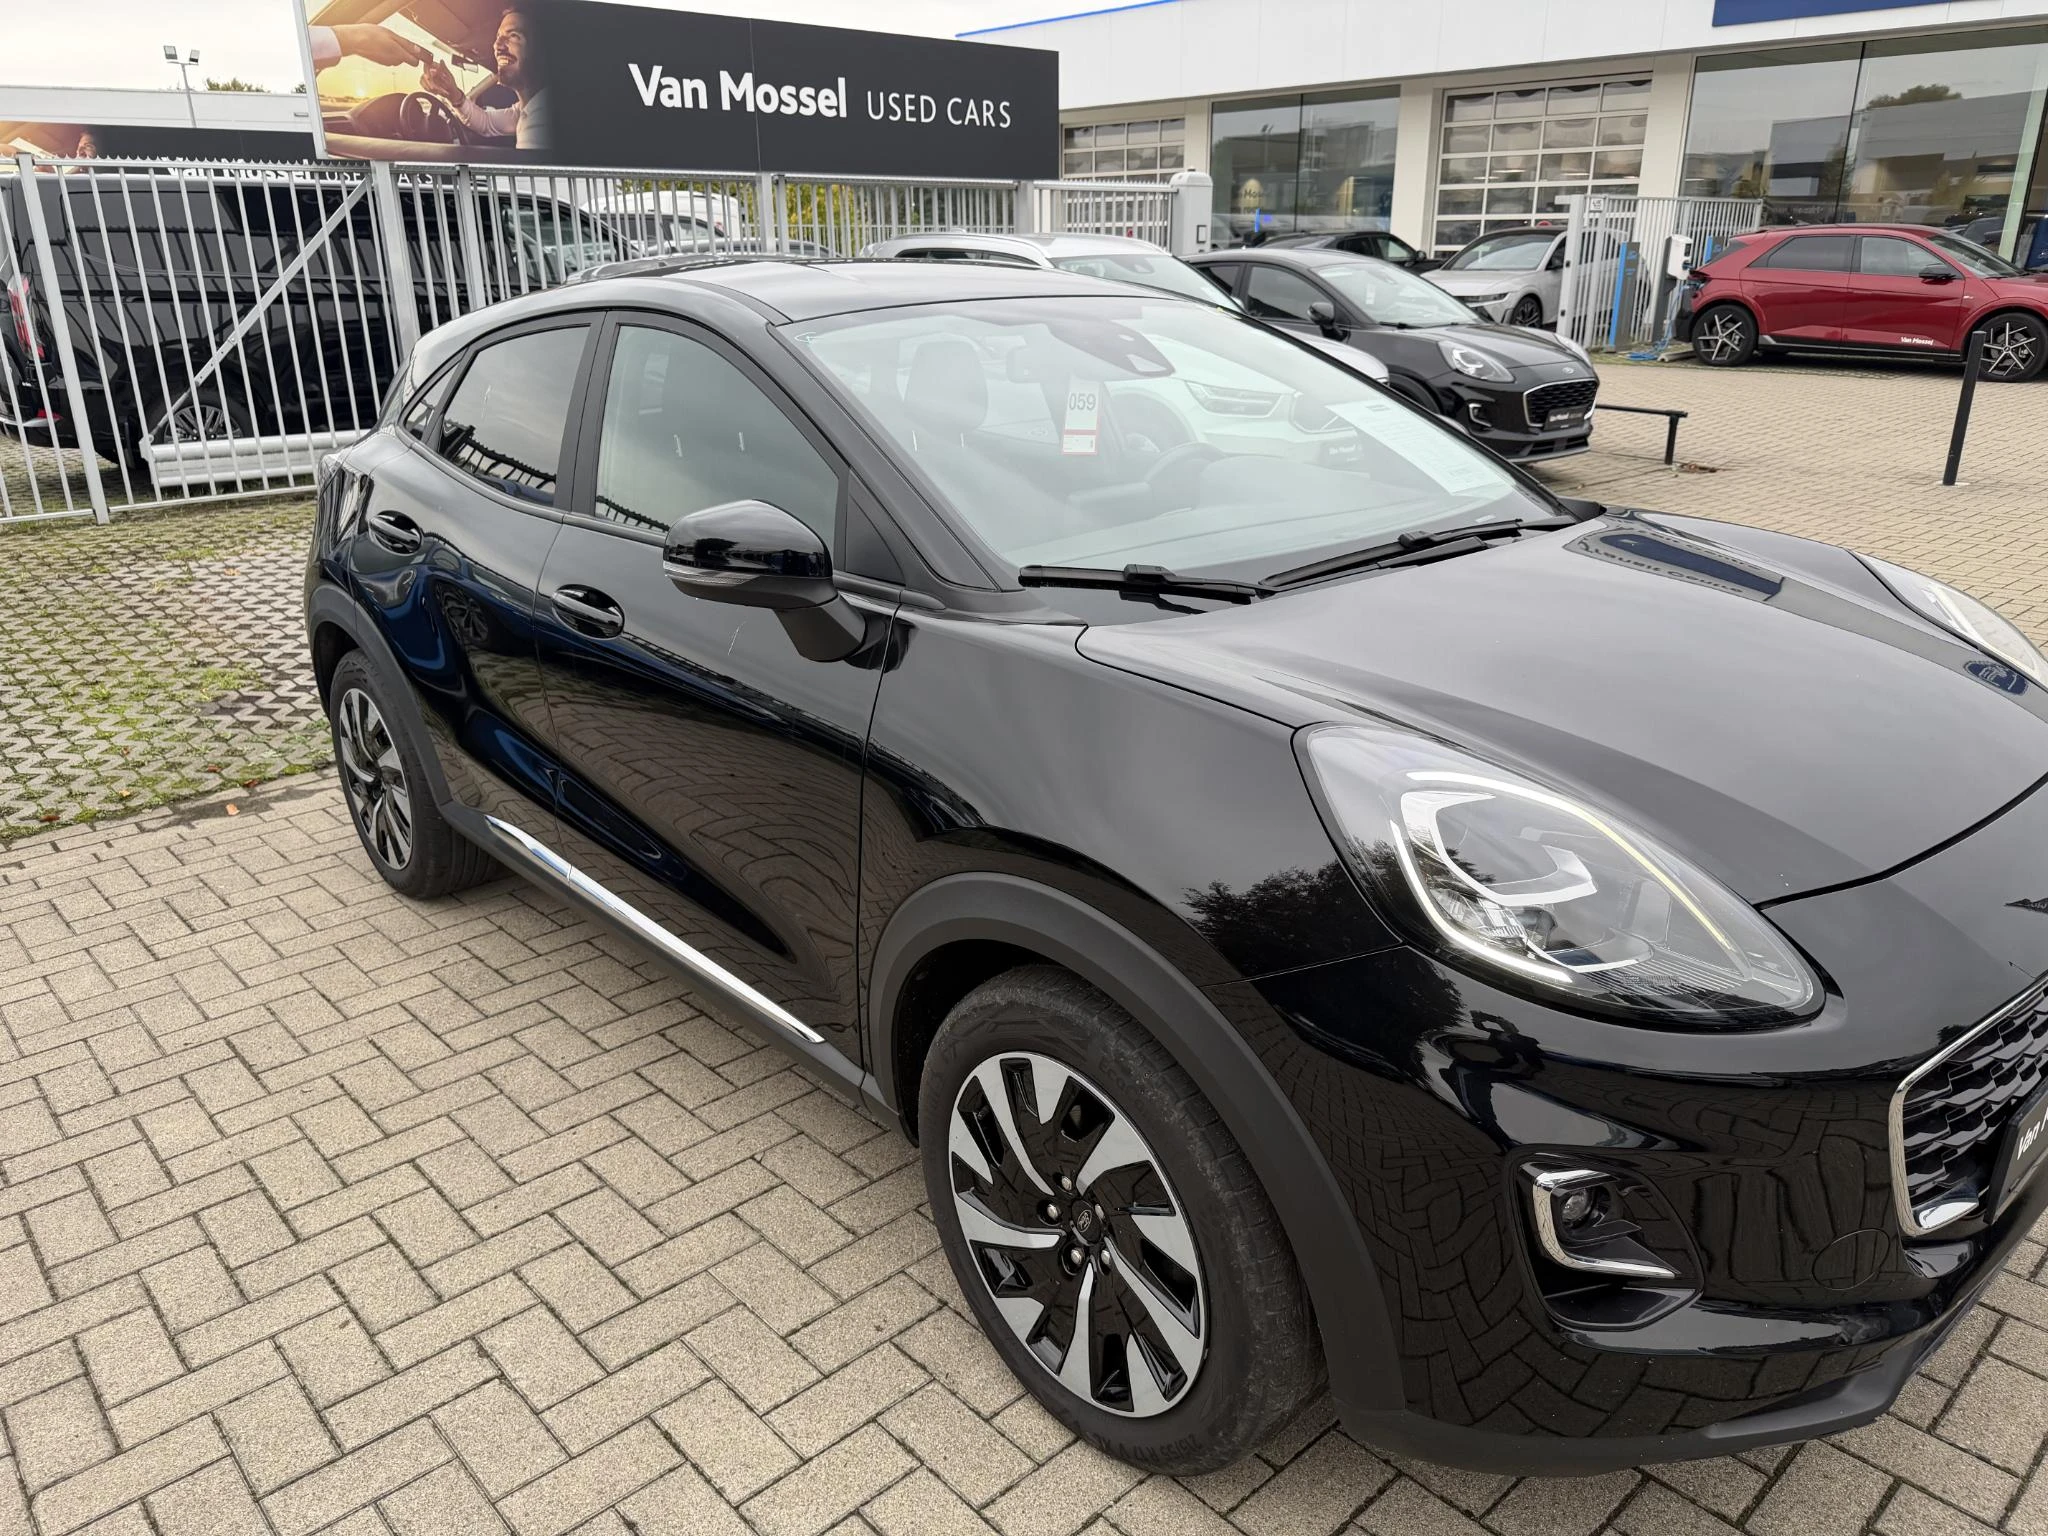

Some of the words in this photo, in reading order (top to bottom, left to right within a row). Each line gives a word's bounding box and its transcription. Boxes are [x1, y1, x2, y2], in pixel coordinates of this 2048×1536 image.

[628, 64, 708, 110] Van
[719, 70, 847, 118] Mossel
[867, 90, 937, 123] USED
[947, 98, 1011, 129] CARS
[1069, 393, 1096, 411] 059
[2017, 1121, 2041, 1160] Van
